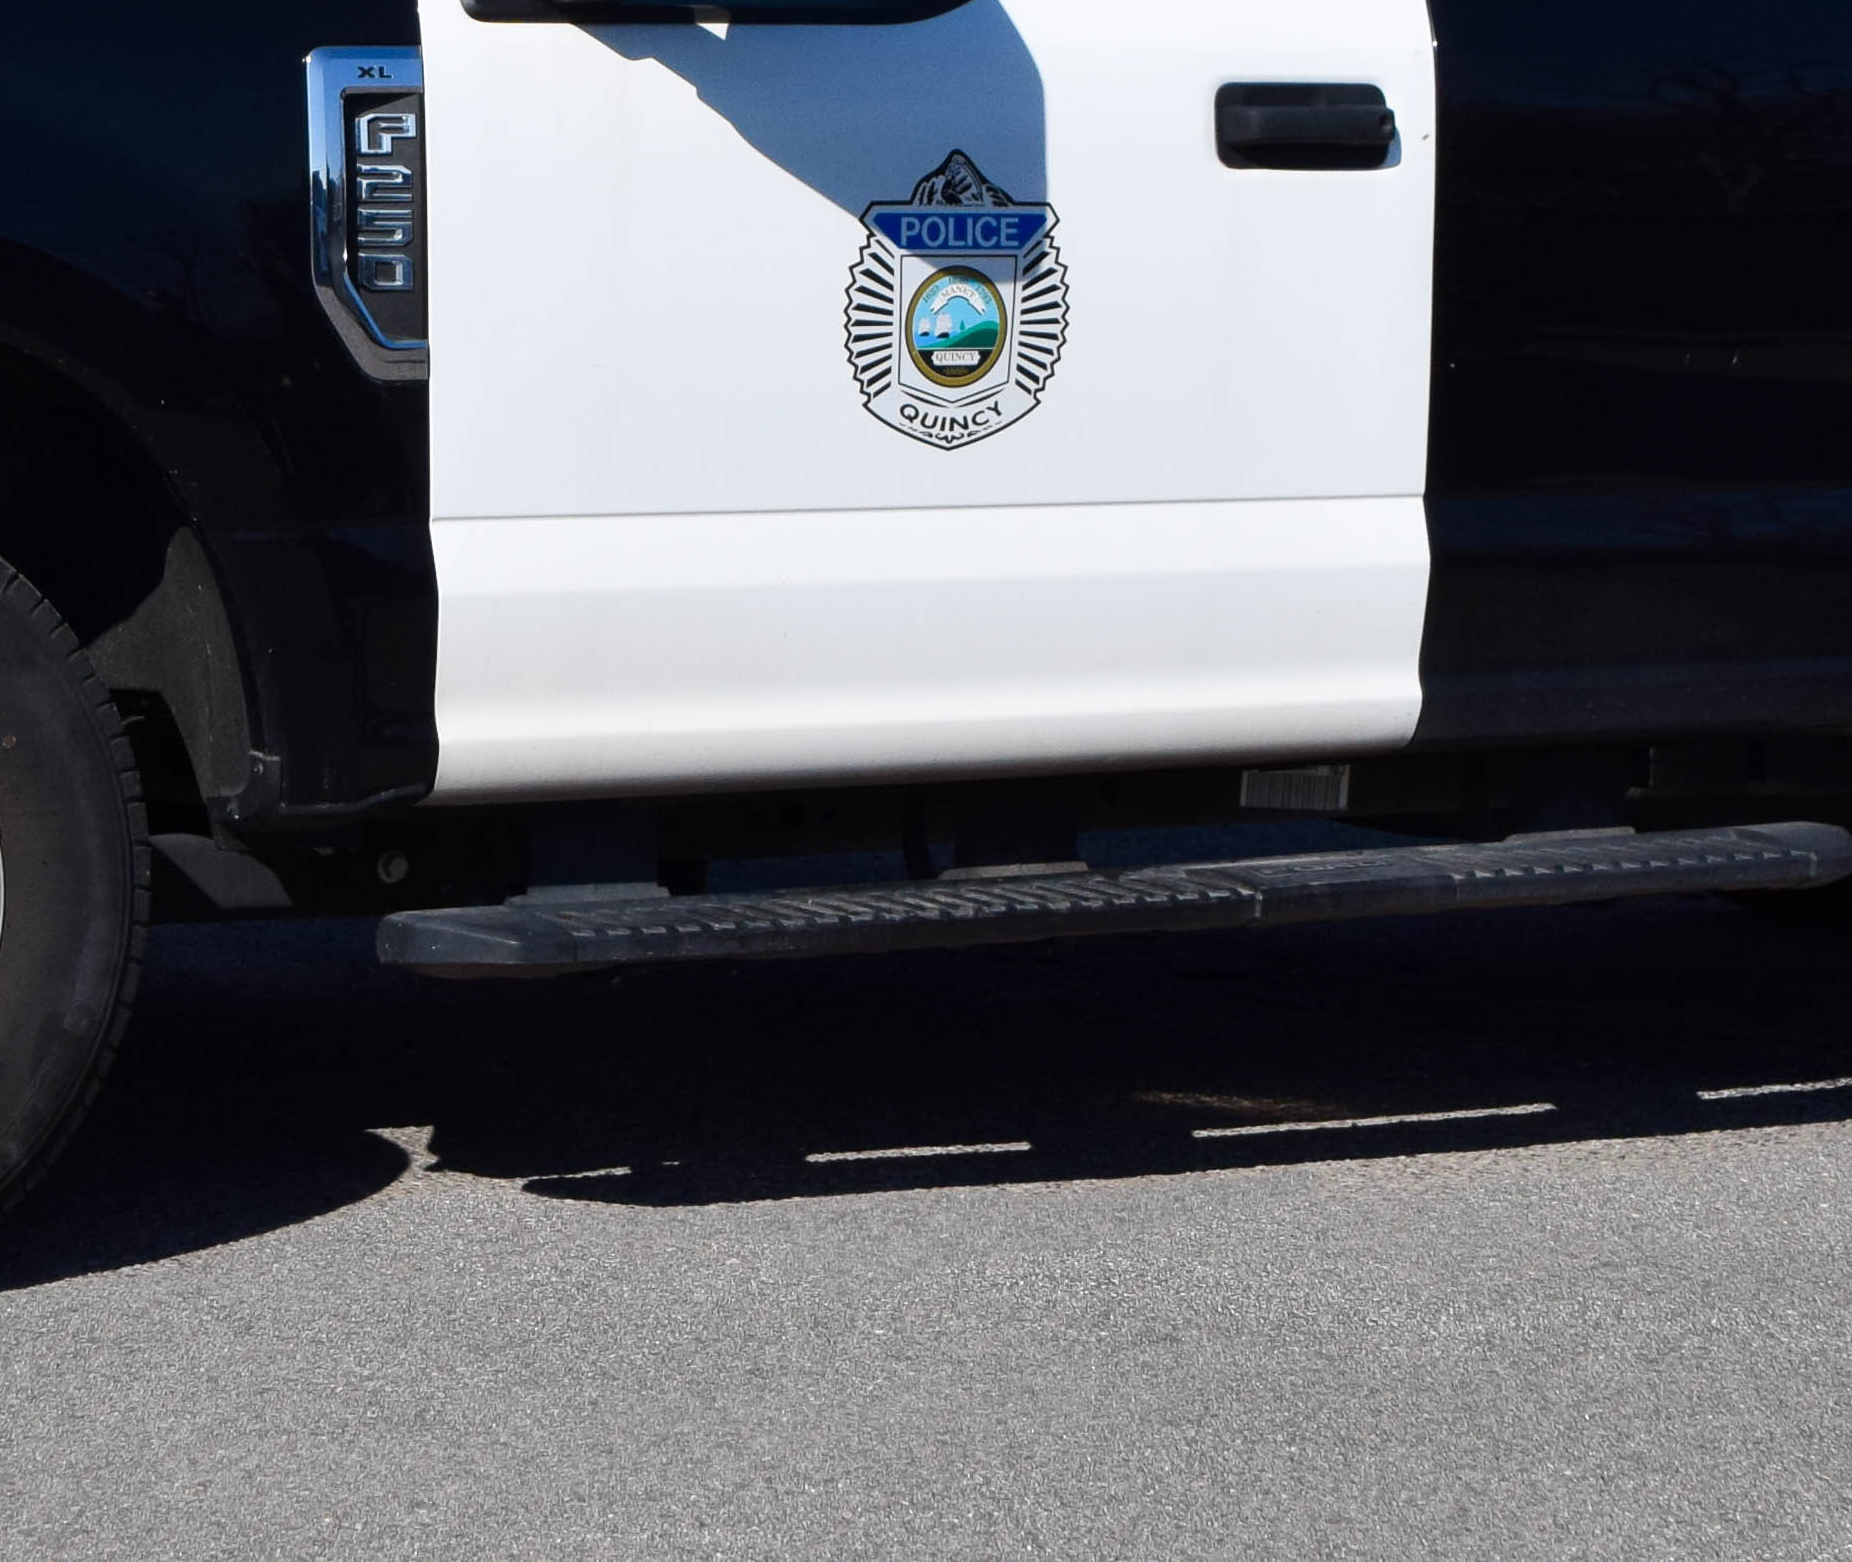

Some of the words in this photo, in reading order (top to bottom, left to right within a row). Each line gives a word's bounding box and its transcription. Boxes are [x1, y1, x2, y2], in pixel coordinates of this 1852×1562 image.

[357, 66, 395, 79] XL
[899, 216, 1020, 248] POLICE
[936, 351, 977, 362] QUINCY
[899, 400, 1004, 433] QUINCY
